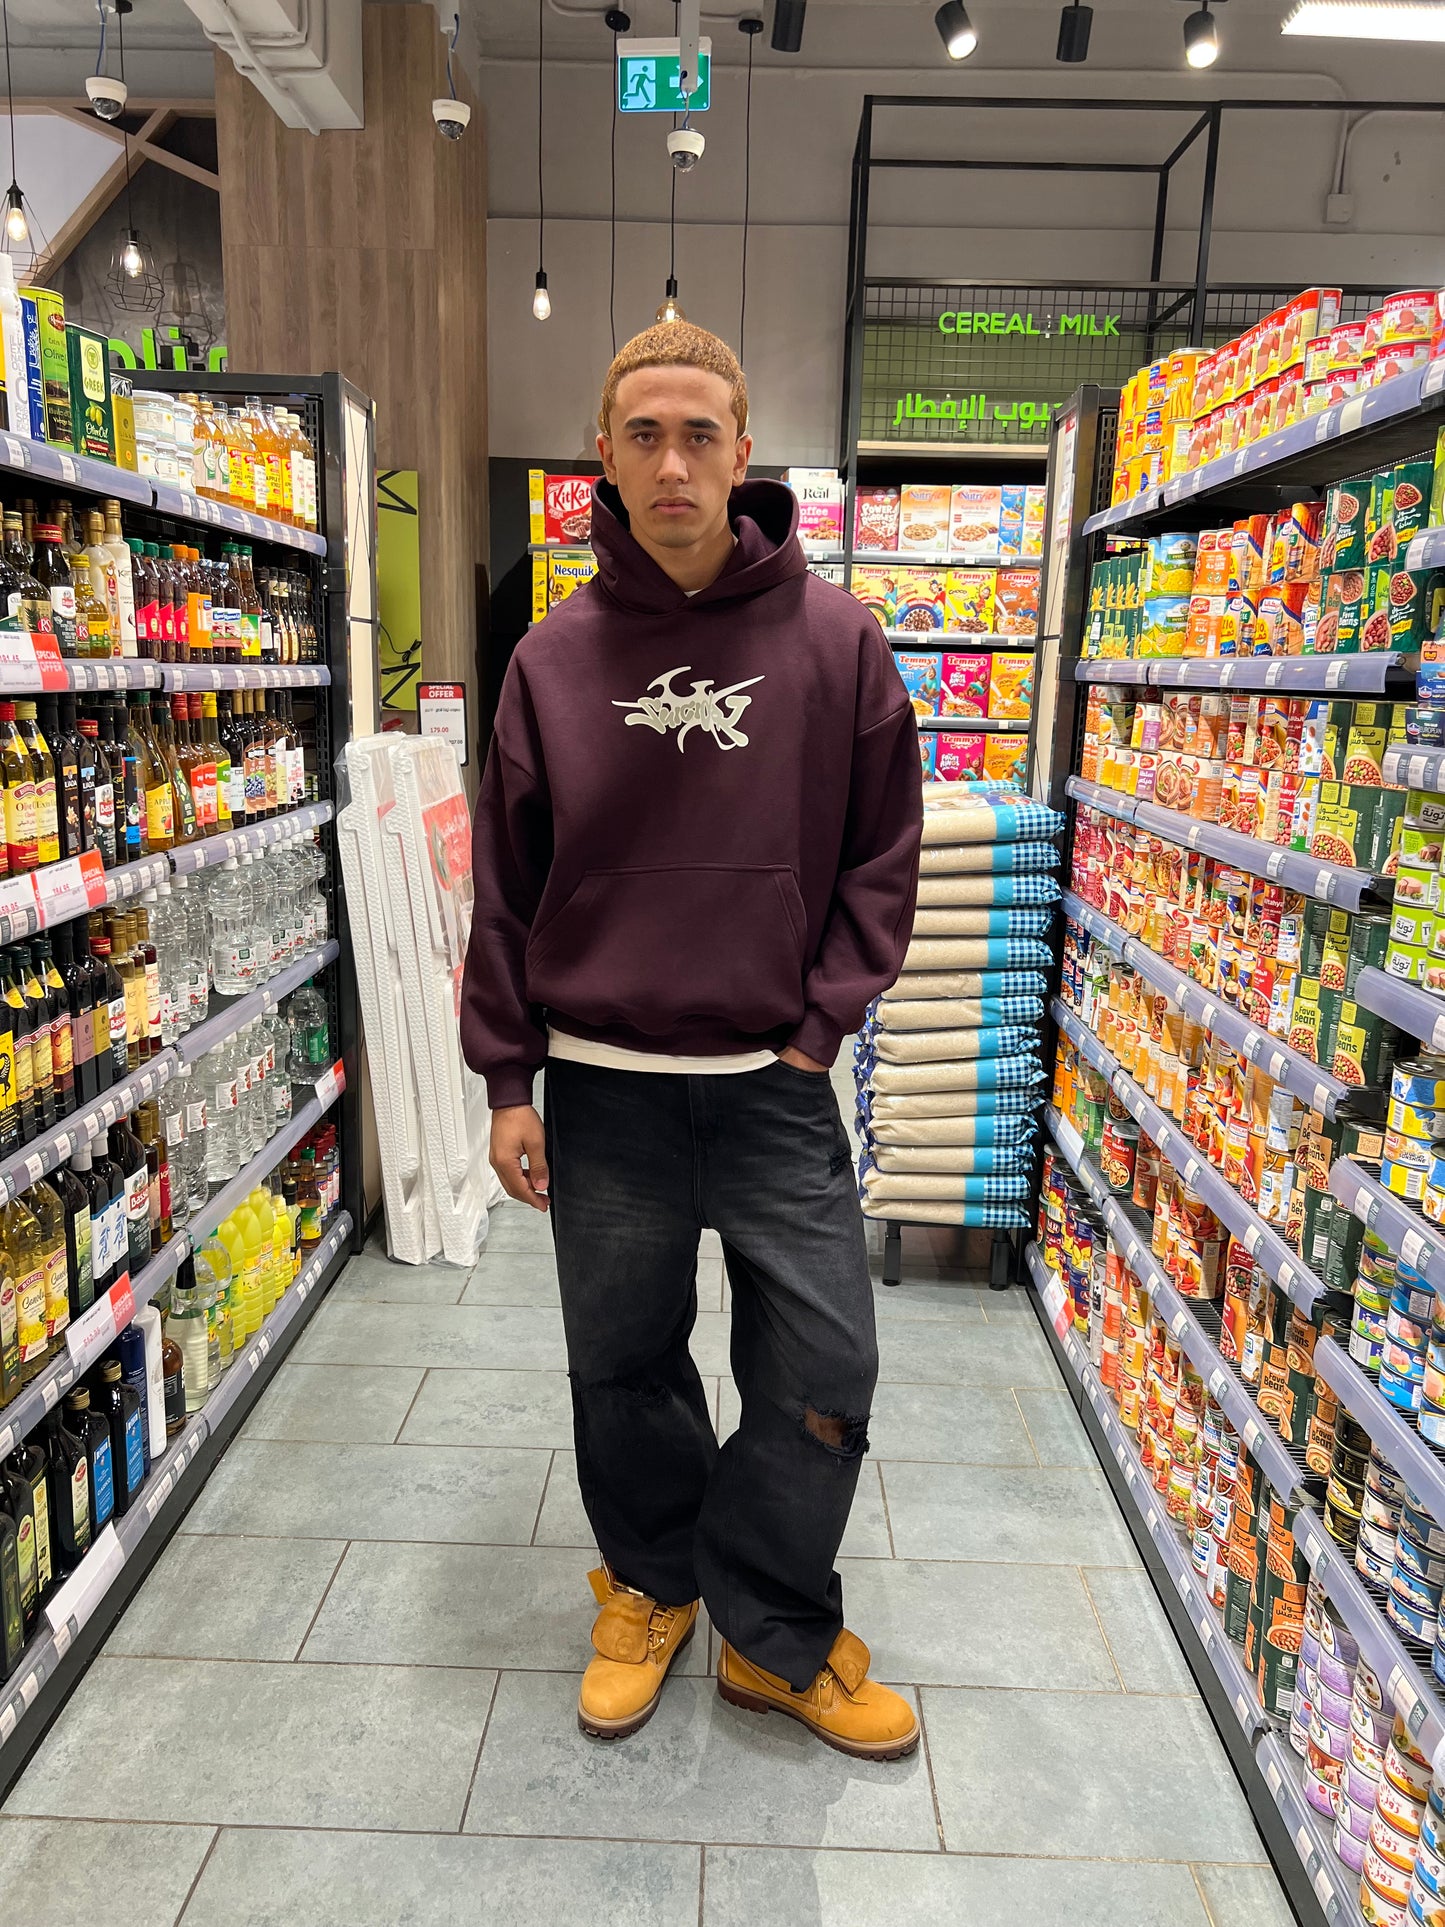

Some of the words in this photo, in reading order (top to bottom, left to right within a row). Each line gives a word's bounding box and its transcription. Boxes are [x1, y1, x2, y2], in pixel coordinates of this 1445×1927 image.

[1387, 298, 1415, 311] HANA
[938, 311, 1040, 335] CEREAL
[1059, 313, 1121, 337] MILK
[83, 376, 104, 394] GREEK
[892, 392, 986, 430] الإفطار
[994, 401, 1063, 429] بوب
[553, 482, 591, 511] KitKat
[803, 486, 830, 500] Real
[800, 507, 828, 516] offee
[799, 516, 819, 525] ites
[554, 564, 594, 578] Nesquik
[858, 567, 891, 576] Temmy's
[906, 568, 940, 577] Temmy's
[952, 571, 992, 581] Temmy's
[1002, 573, 1038, 582] Temmy
[36, 650, 60, 660] SPECIAL
[898, 655, 938, 664] Temmy's
[947, 656, 988, 666] Temmy's
[998, 656, 1033, 666] Temmy
[39, 660, 64, 673] OFFER
[428, 690, 454, 698] OFFER
[942, 734, 981, 744] Temmy's
[1352, 728, 1376, 739] فول
[1349, 737, 1382, 747] مدمس
[82, 869, 102, 880] SPECIAL
[85, 876, 105, 891] OFFER
[1396, 919, 1414, 933] تونة
[1392, 955, 1411, 970] تونة
[1300, 1005, 1316, 1017] Fava
[1294, 1013, 1316, 1026] Bean
[1336, 1041, 1358, 1054] eans
[1268, 1372, 1285, 1384] Fava
[1311, 1431, 1332, 1449] Bean
[1389, 1758, 1414, 1784] Rose
